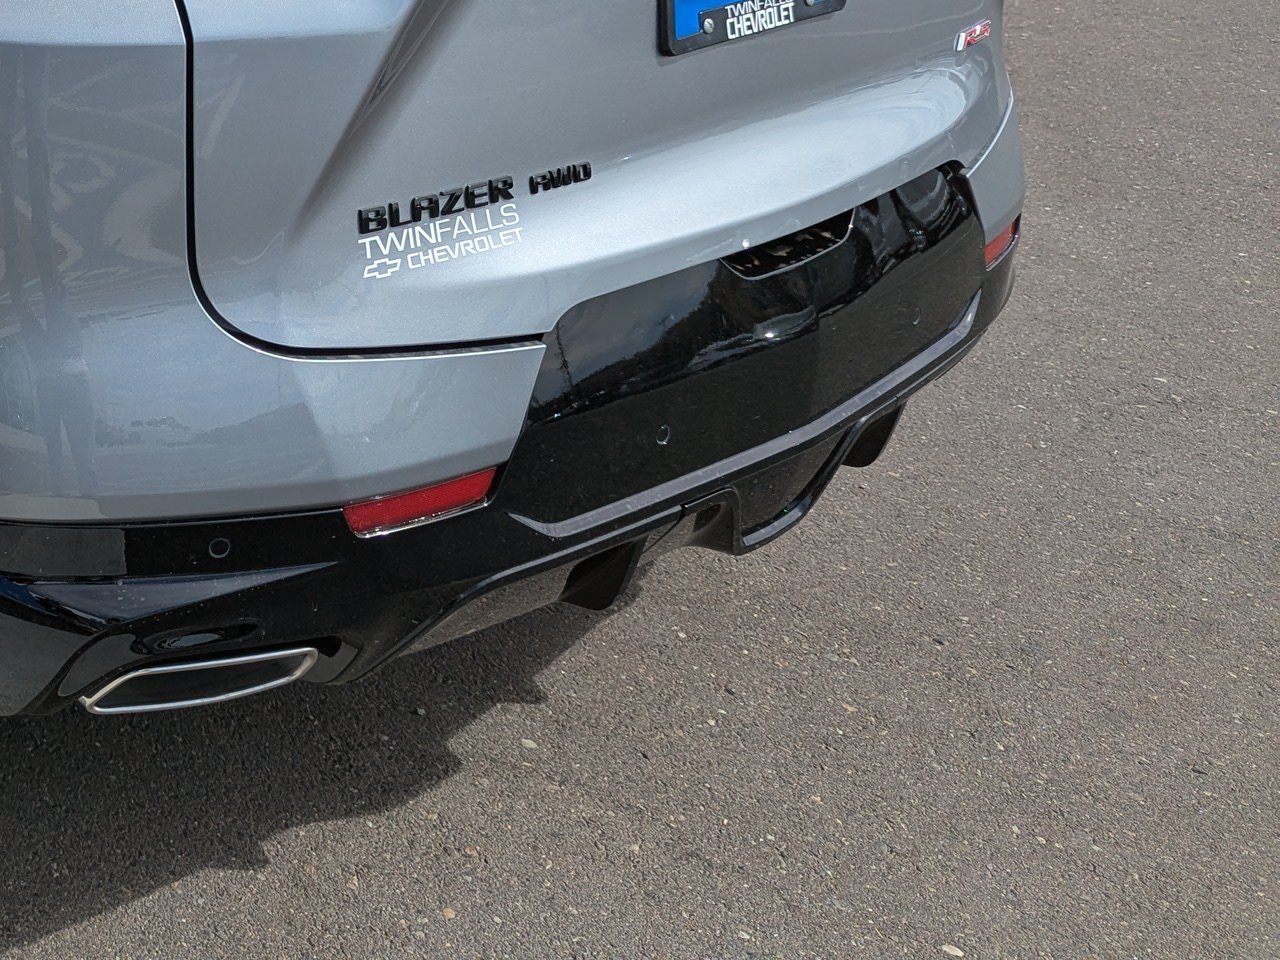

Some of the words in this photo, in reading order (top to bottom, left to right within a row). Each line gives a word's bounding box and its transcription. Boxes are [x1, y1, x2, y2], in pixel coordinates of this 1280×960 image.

[726, 2, 795, 40] CHEVROLET
[358, 175, 515, 235] BLAZER
[358, 203, 520, 259] TWINFALLS
[406, 227, 523, 269] CHEVROLET
